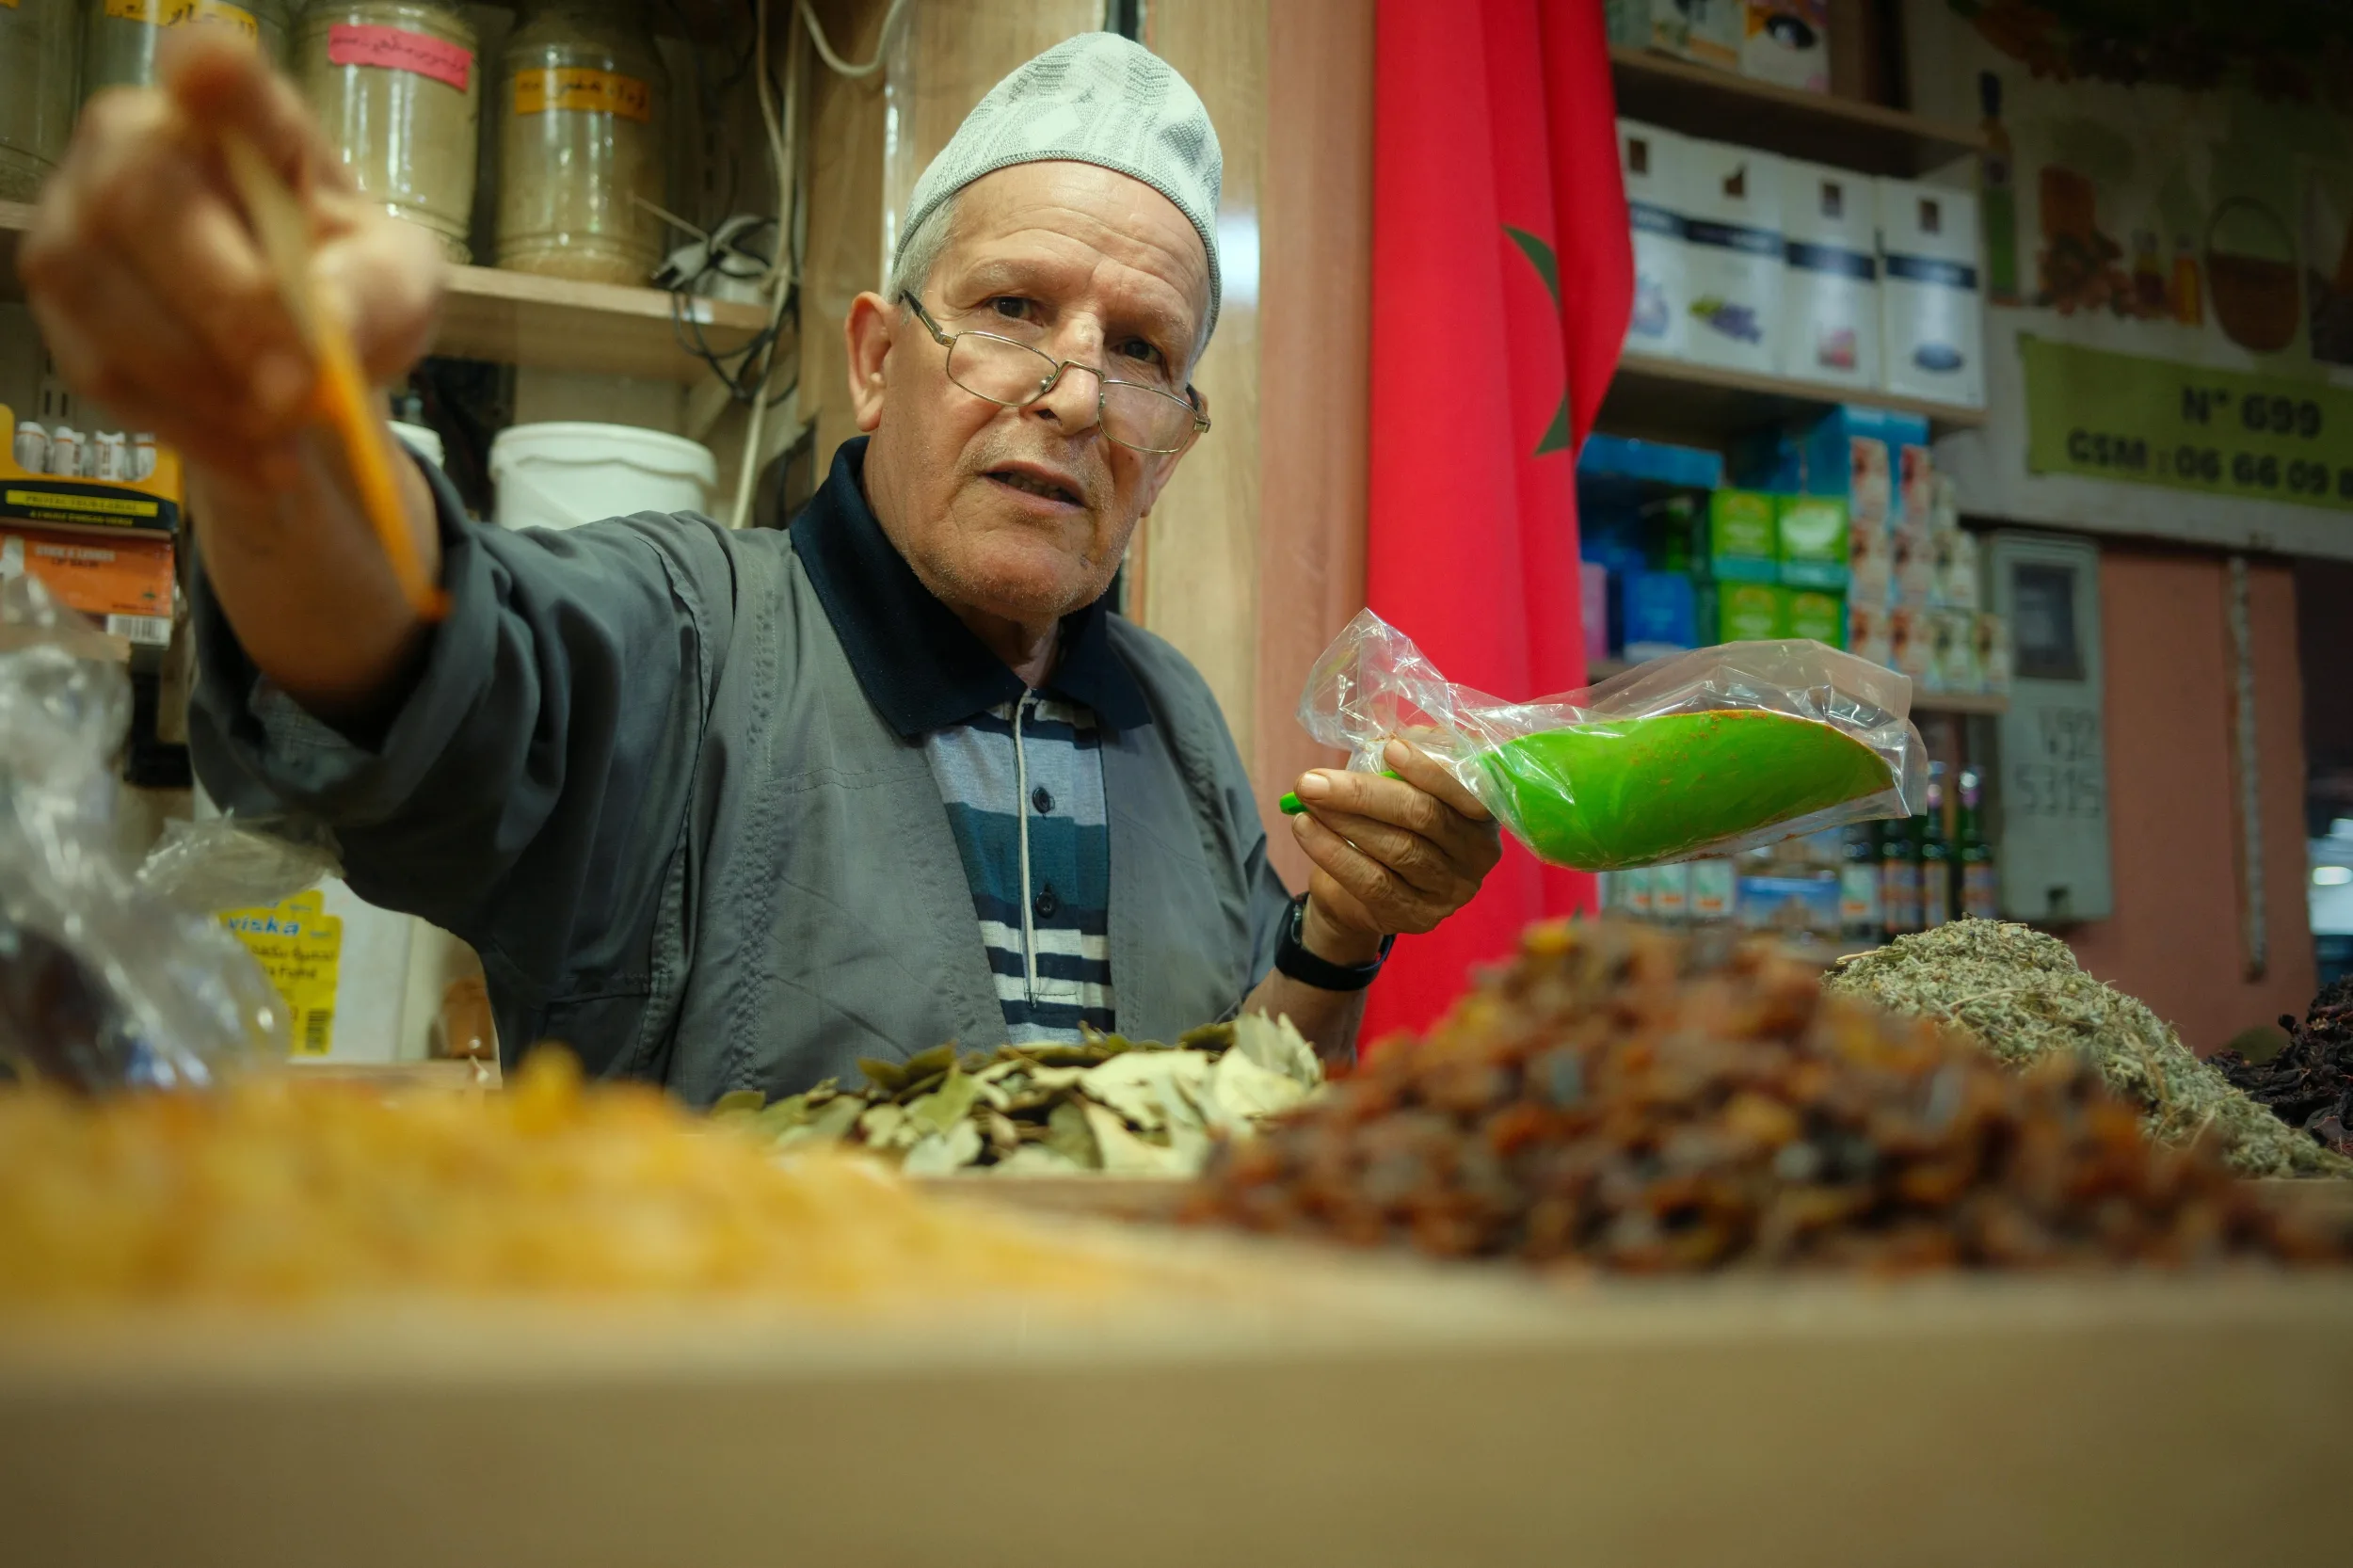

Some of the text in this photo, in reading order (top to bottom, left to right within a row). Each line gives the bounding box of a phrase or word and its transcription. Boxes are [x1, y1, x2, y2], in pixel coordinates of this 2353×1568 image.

[2240, 392, 2322, 440] 699
[2174, 444, 2222, 484] 06
[2231, 452, 2280, 488] 66
[2286, 457, 2330, 497] 09
